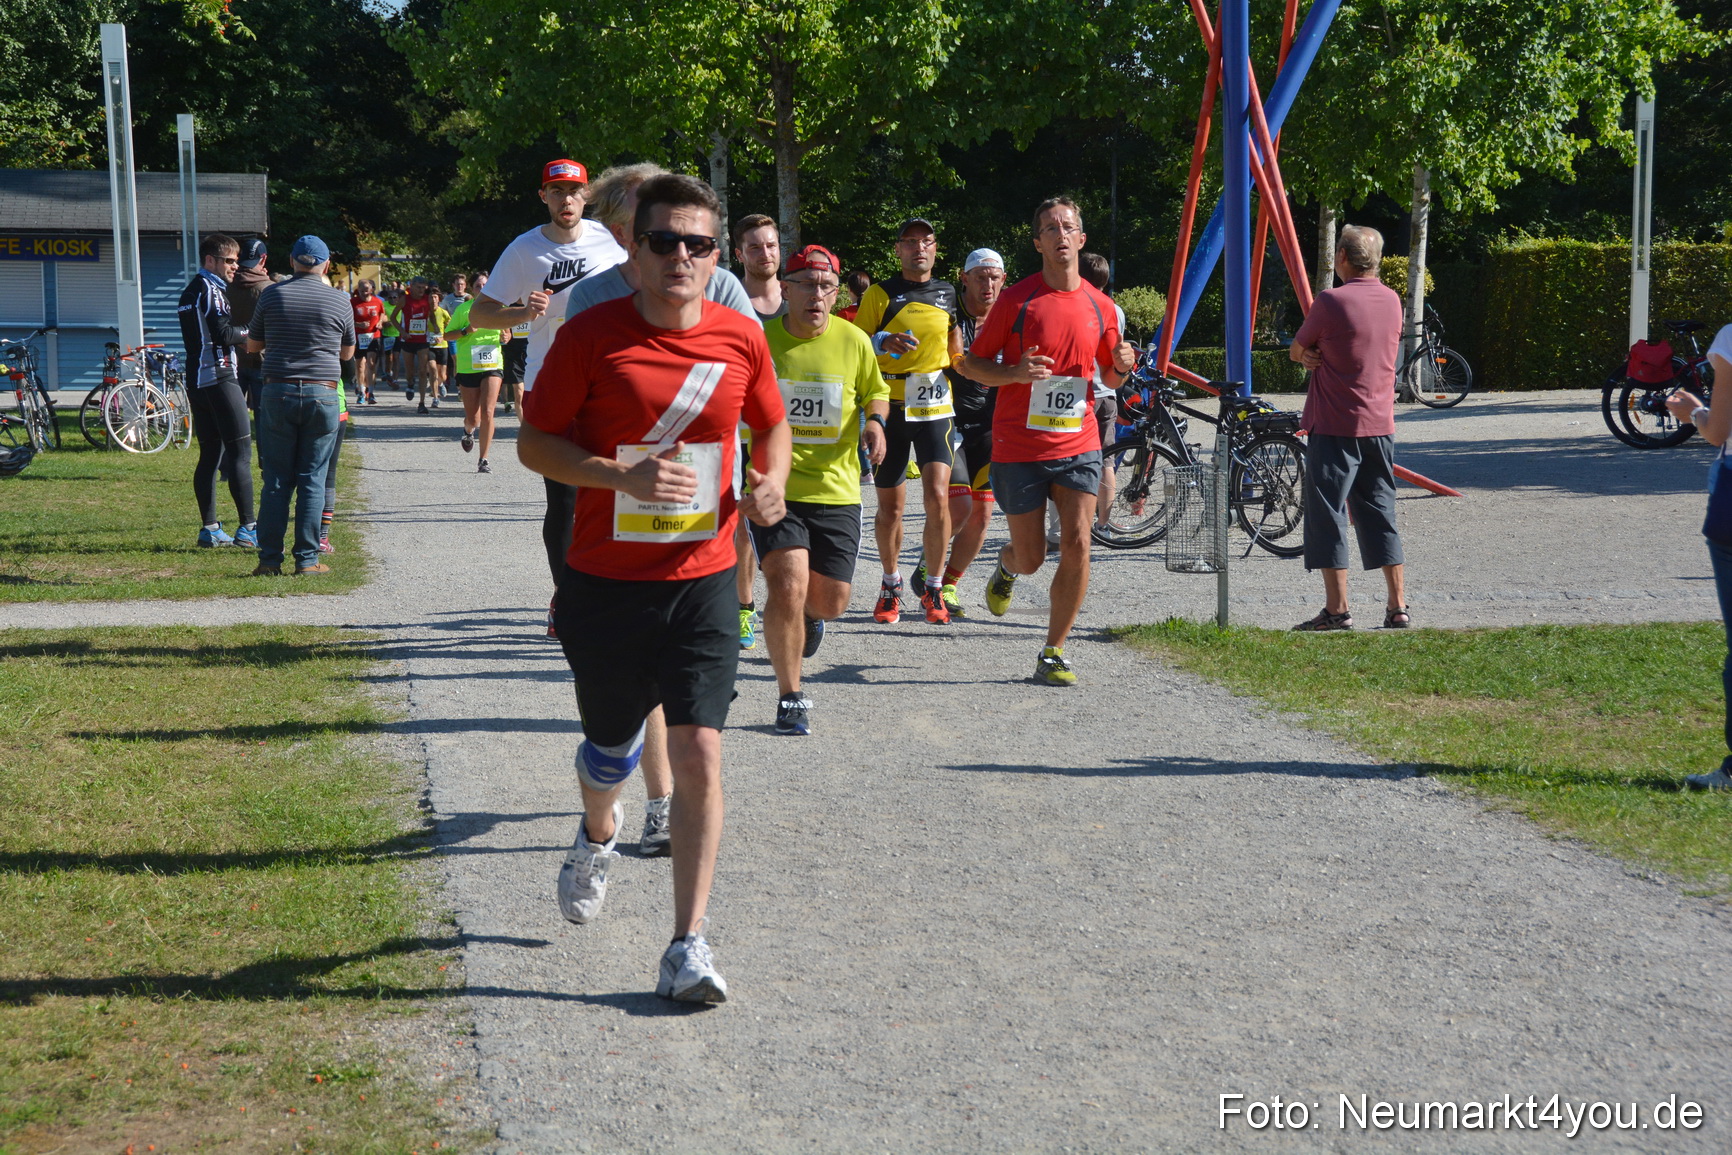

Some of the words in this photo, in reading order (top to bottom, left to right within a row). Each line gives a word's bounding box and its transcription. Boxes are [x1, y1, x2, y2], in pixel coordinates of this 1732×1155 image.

[34, 239, 94, 256] KIOSK
[550, 258, 587, 280] NIKE
[479, 352, 492, 361] 153
[794, 386, 824, 395] BOCK
[917, 385, 943, 400] 218
[790, 397, 824, 418] 291
[1046, 391, 1074, 410] 162
[920, 407, 940, 416] Steffen
[1049, 418, 1066, 427] Maik
[791, 426, 823, 437] Thomas
[652, 515, 686, 531] Ömer
